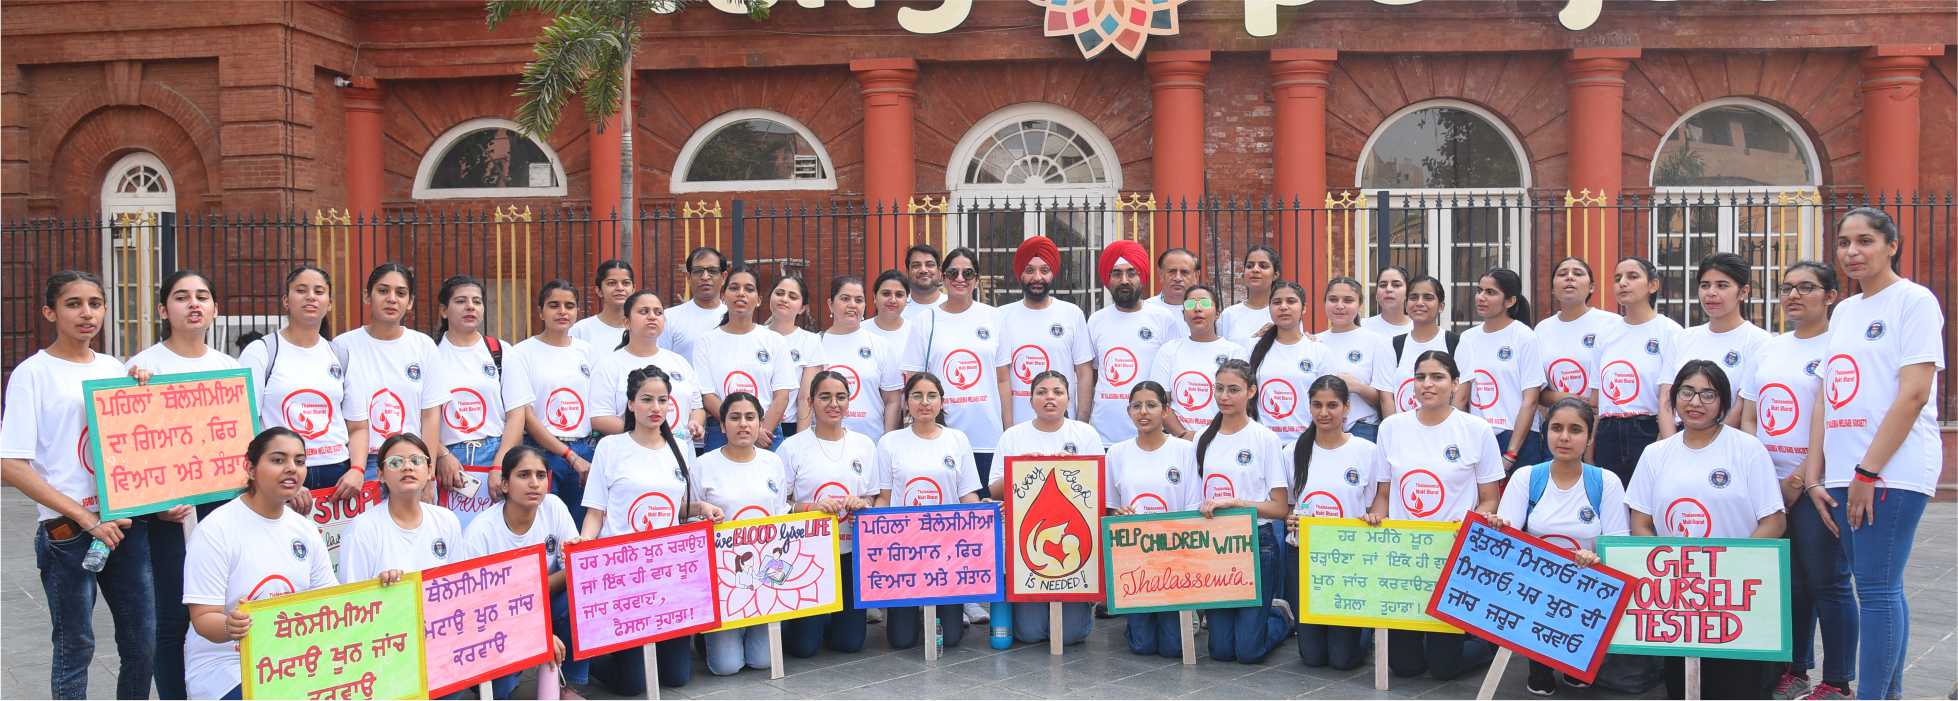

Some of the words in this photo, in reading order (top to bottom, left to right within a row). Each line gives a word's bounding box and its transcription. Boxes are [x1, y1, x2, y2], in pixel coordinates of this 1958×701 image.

[107, 433, 127, 453] ਦਾ
[208, 416, 238, 442] ਫਿਰ
[111, 465, 166, 492] ਵਿਆਹ
[174, 456, 203, 482] ਅਤੇ
[1110, 527, 1142, 548] HELP
[1140, 530, 1209, 553] CHILDREN
[1213, 534, 1254, 554] WITH
[1337, 529, 1357, 543] ਹਰ
[579, 555, 598, 570] ਹਰ
[867, 547, 883, 562] ਦਾ
[955, 539, 983, 558] ਫਿਰ
[1416, 553, 1431, 568] ਹੀ
[1646, 545, 1727, 578] GET
[629, 566, 646, 584] ਹੀ
[867, 571, 916, 589] ਵਿਆਹ
[923, 568, 948, 586] ਅਤੇ
[956, 566, 991, 585] ਸੰਤਾਨ
[1516, 582, 1543, 605] ਪਰ
[1581, 608, 1606, 629] ਦੀ
[1634, 577, 1762, 611] OURSELF
[1626, 609, 1743, 643] TESTED
